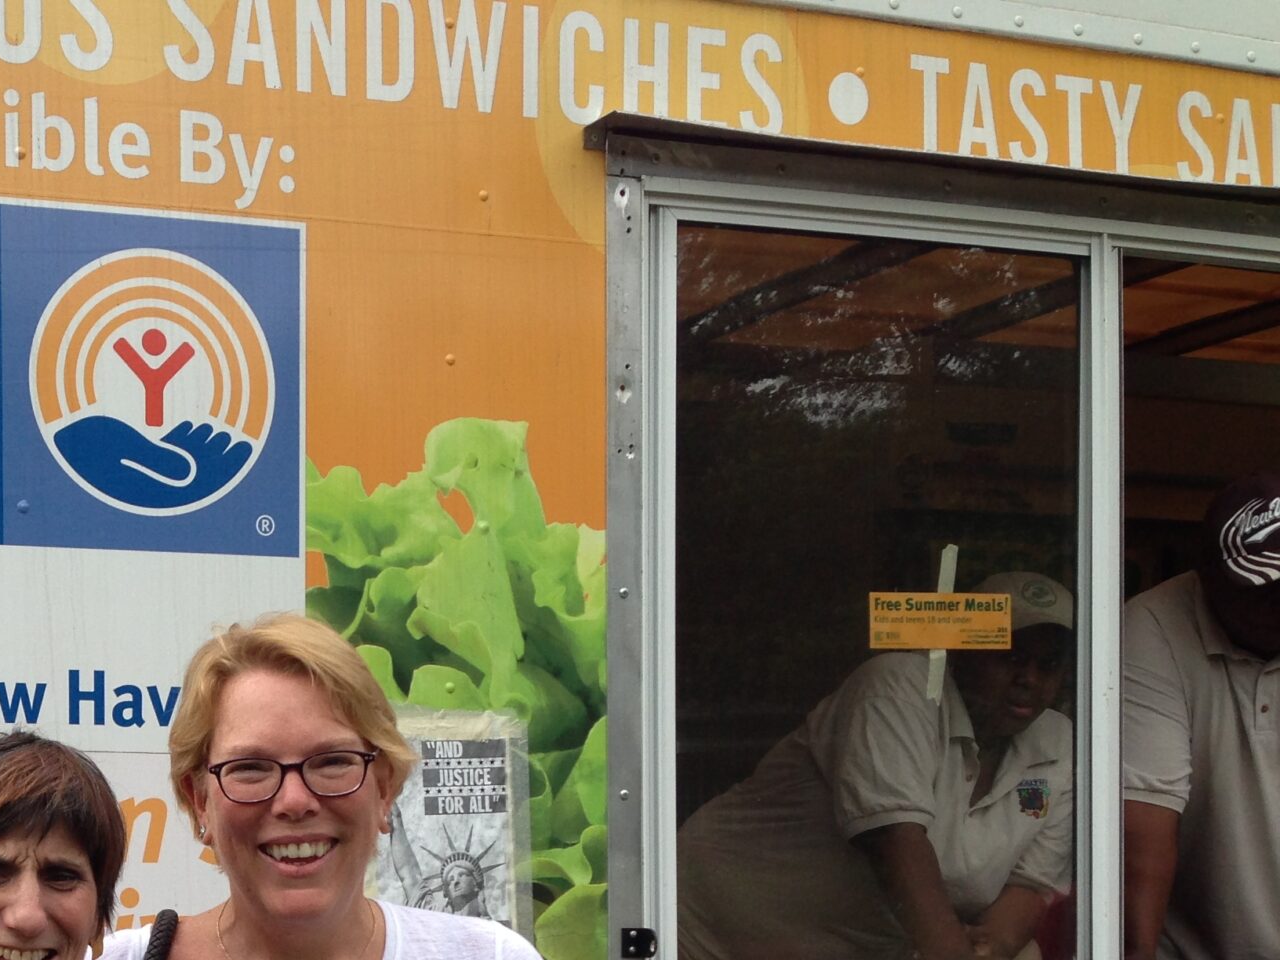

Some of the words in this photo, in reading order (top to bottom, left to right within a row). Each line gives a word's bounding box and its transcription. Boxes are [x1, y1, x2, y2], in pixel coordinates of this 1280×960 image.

[163, 0, 783, 134] SANDWICHES
[910, 54, 1143, 176] TASTY
[1176, 90, 1280, 187] SA
[180, 109, 297, 210] By:
[874, 597, 902, 612] Free
[905, 597, 961, 613] Summer
[964, 596, 1009, 615] Meals!
[68, 669, 181, 728] Hav
[436, 767, 492, 787] JUSTICE
[438, 796, 464, 814] FOR
